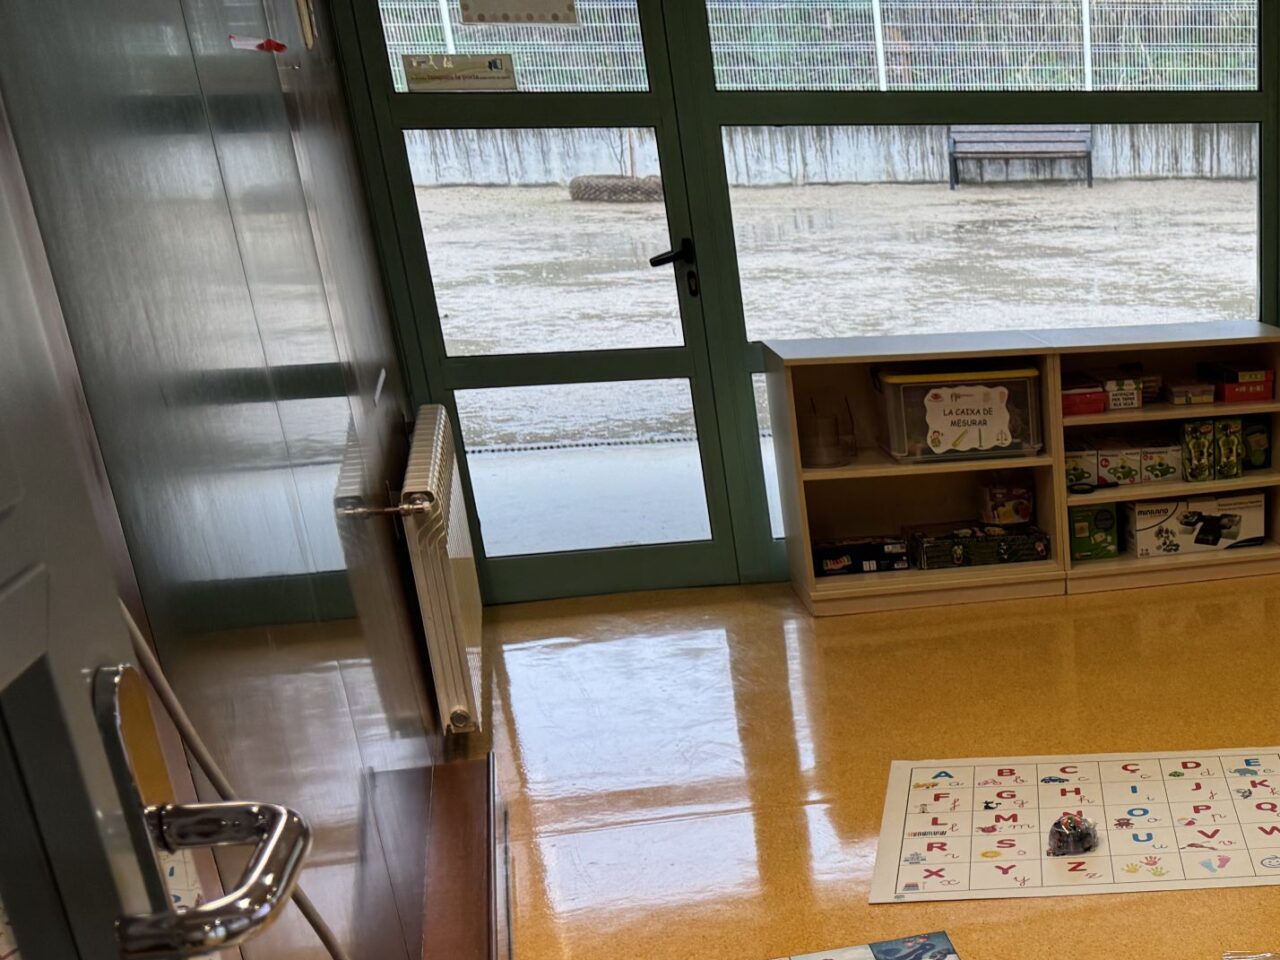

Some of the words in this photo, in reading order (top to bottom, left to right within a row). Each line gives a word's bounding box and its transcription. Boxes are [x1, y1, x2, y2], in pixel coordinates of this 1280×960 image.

[943, 408, 953, 416] LA
[955, 408, 981, 416] CAIXA
[983, 407, 993, 416] DE
[950, 419, 988, 428] MESURAR
[932, 771, 954, 779] A
[1060, 766, 1078, 774] C
[1122, 763, 1140, 774] Ç
[1181, 761, 1201, 769] D
[934, 793, 950, 801] F
[996, 790, 1016, 799] G
[1060, 788, 1081, 796] H
[1192, 783, 1201, 791] J
[1250, 780, 1270, 788] K
[932, 817, 947, 826] L
[995, 814, 1018, 822] M
[1127, 808, 1149, 816] O
[1193, 805, 1211, 813] P
[1256, 802, 1278, 812] Q
[927, 842, 947, 852] R
[997, 839, 1016, 848] S
[1132, 833, 1153, 842] U
[1197, 829, 1220, 839] V
[923, 868, 945, 878] X
[995, 865, 1016, 875] Y
[1067, 862, 1086, 872] Z
